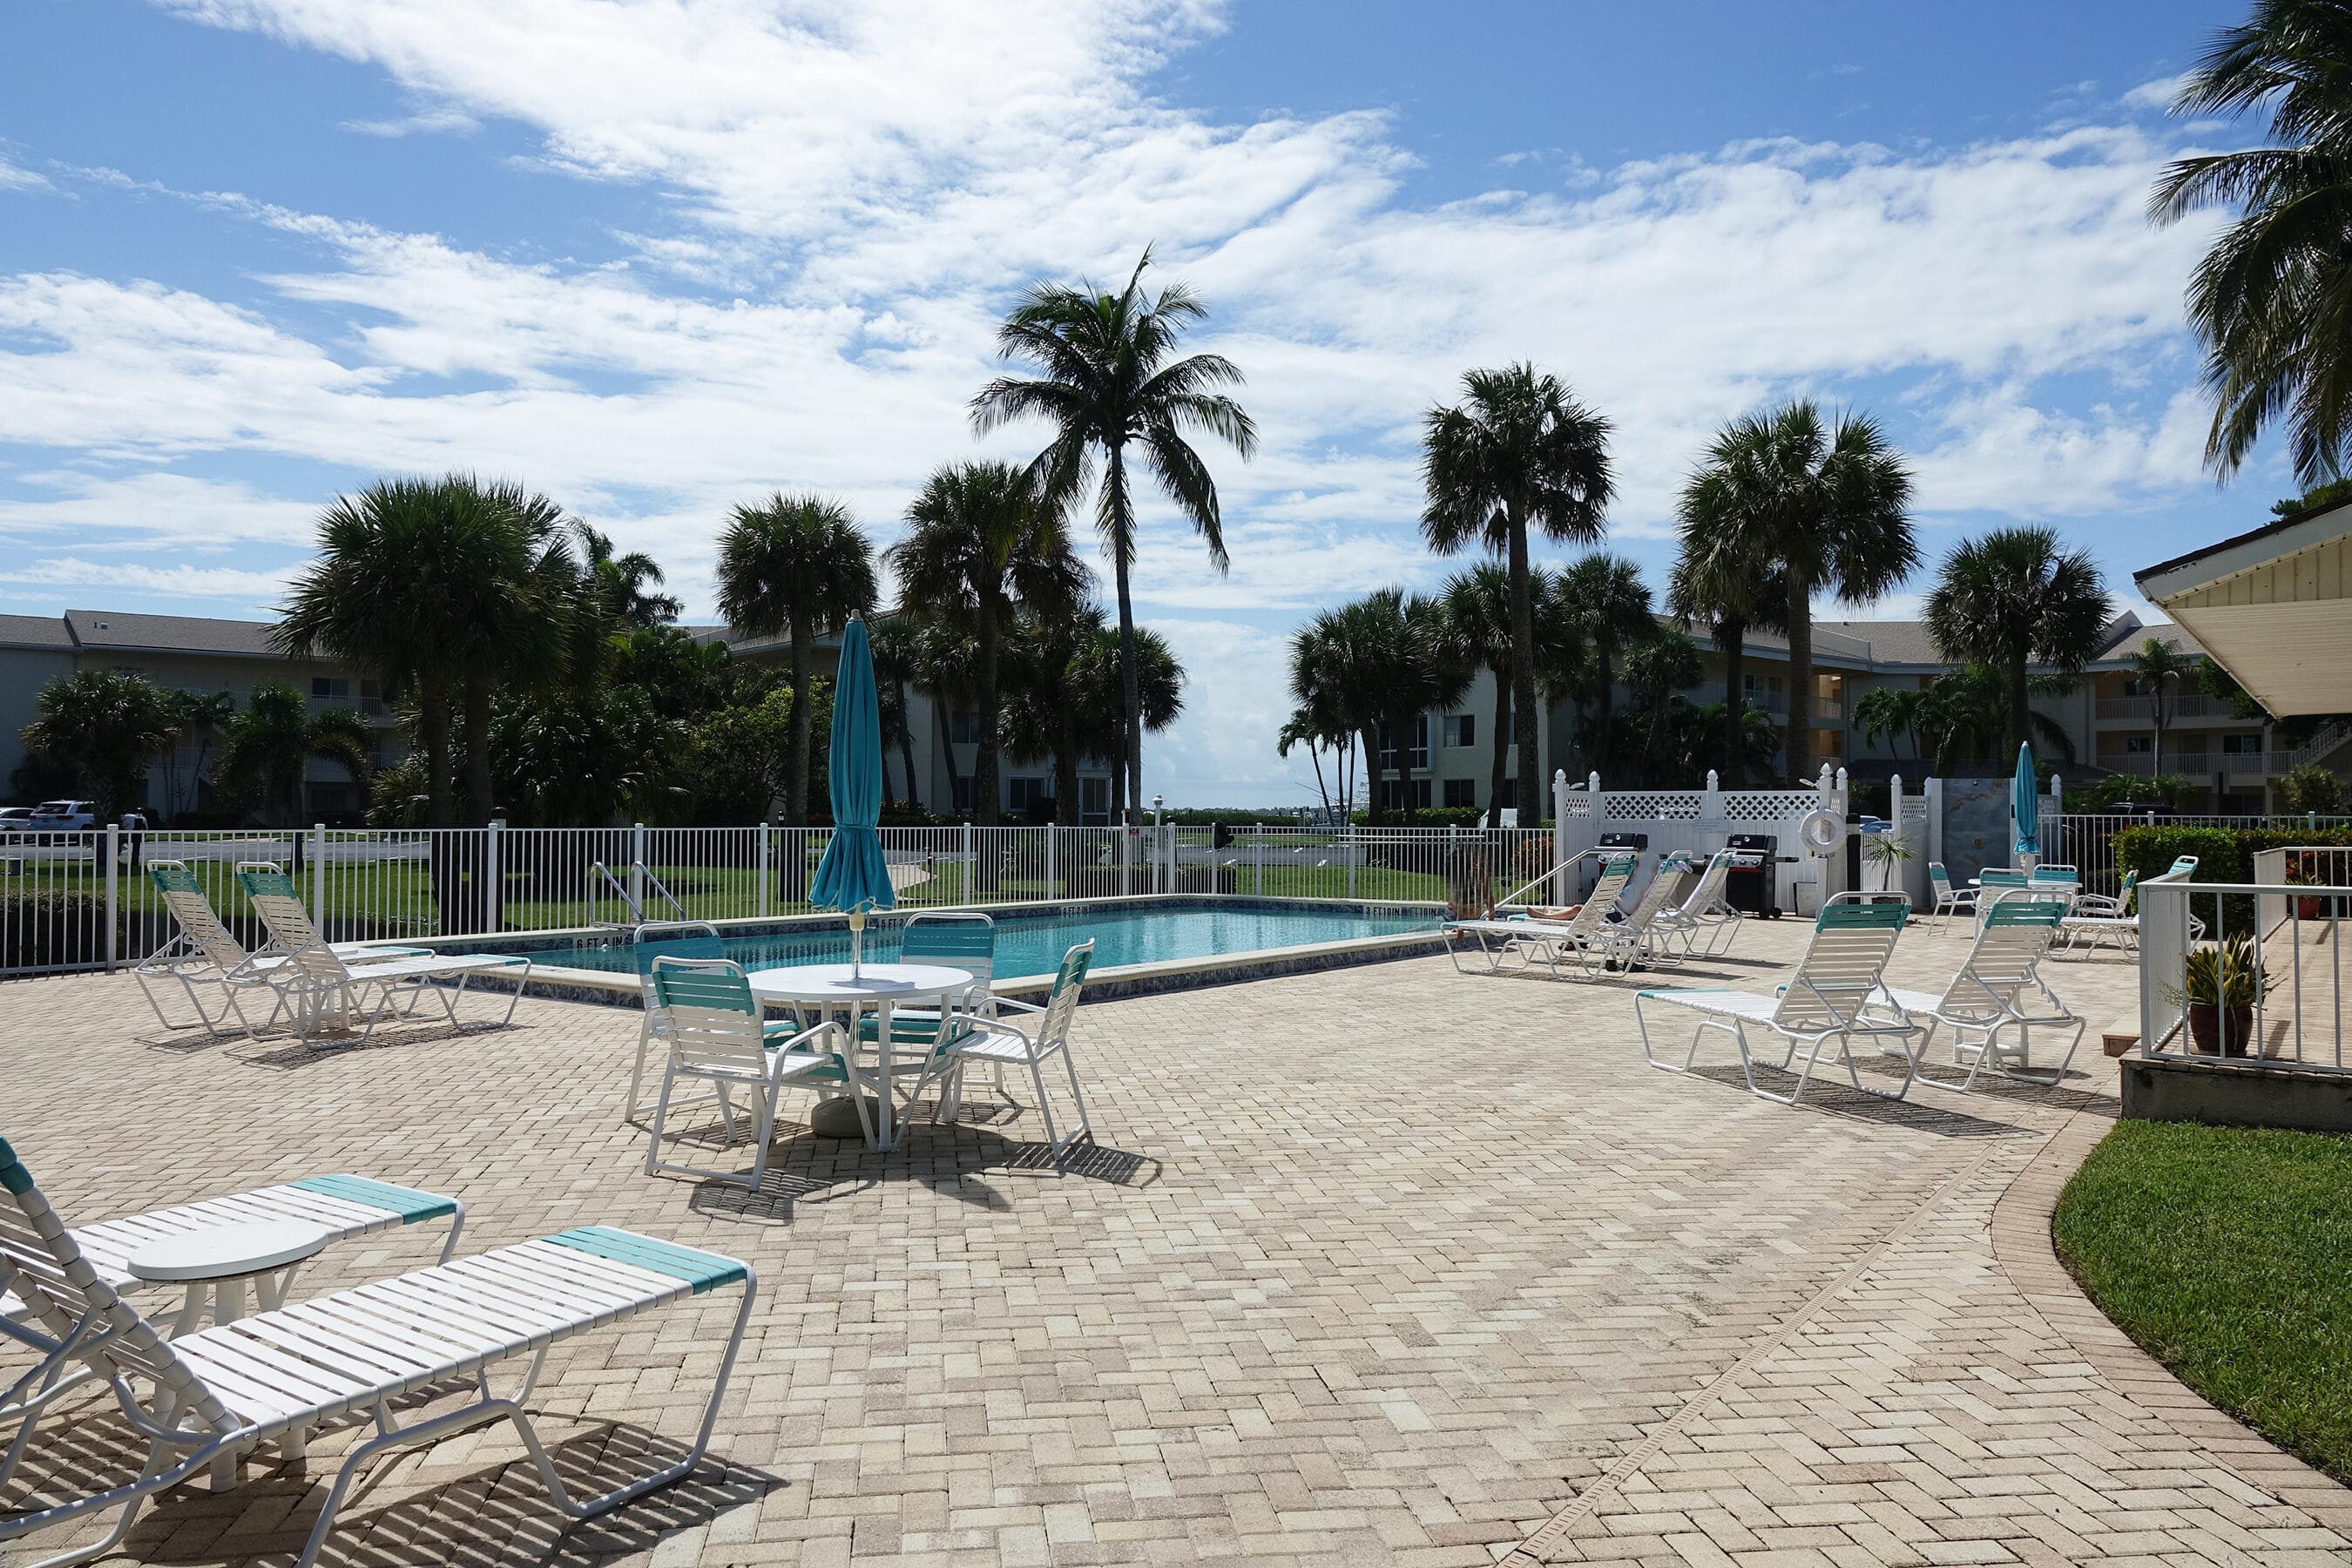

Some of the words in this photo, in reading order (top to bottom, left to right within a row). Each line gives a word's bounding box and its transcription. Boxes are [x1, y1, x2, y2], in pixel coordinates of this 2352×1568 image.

[1365, 906, 1371, 915] 3
[1373, 906, 1382, 916] FT
[888, 918, 897, 928] FT
[577, 938, 583, 949] 6
[586, 937, 599, 949] FT
[612, 936, 623, 948] IN
